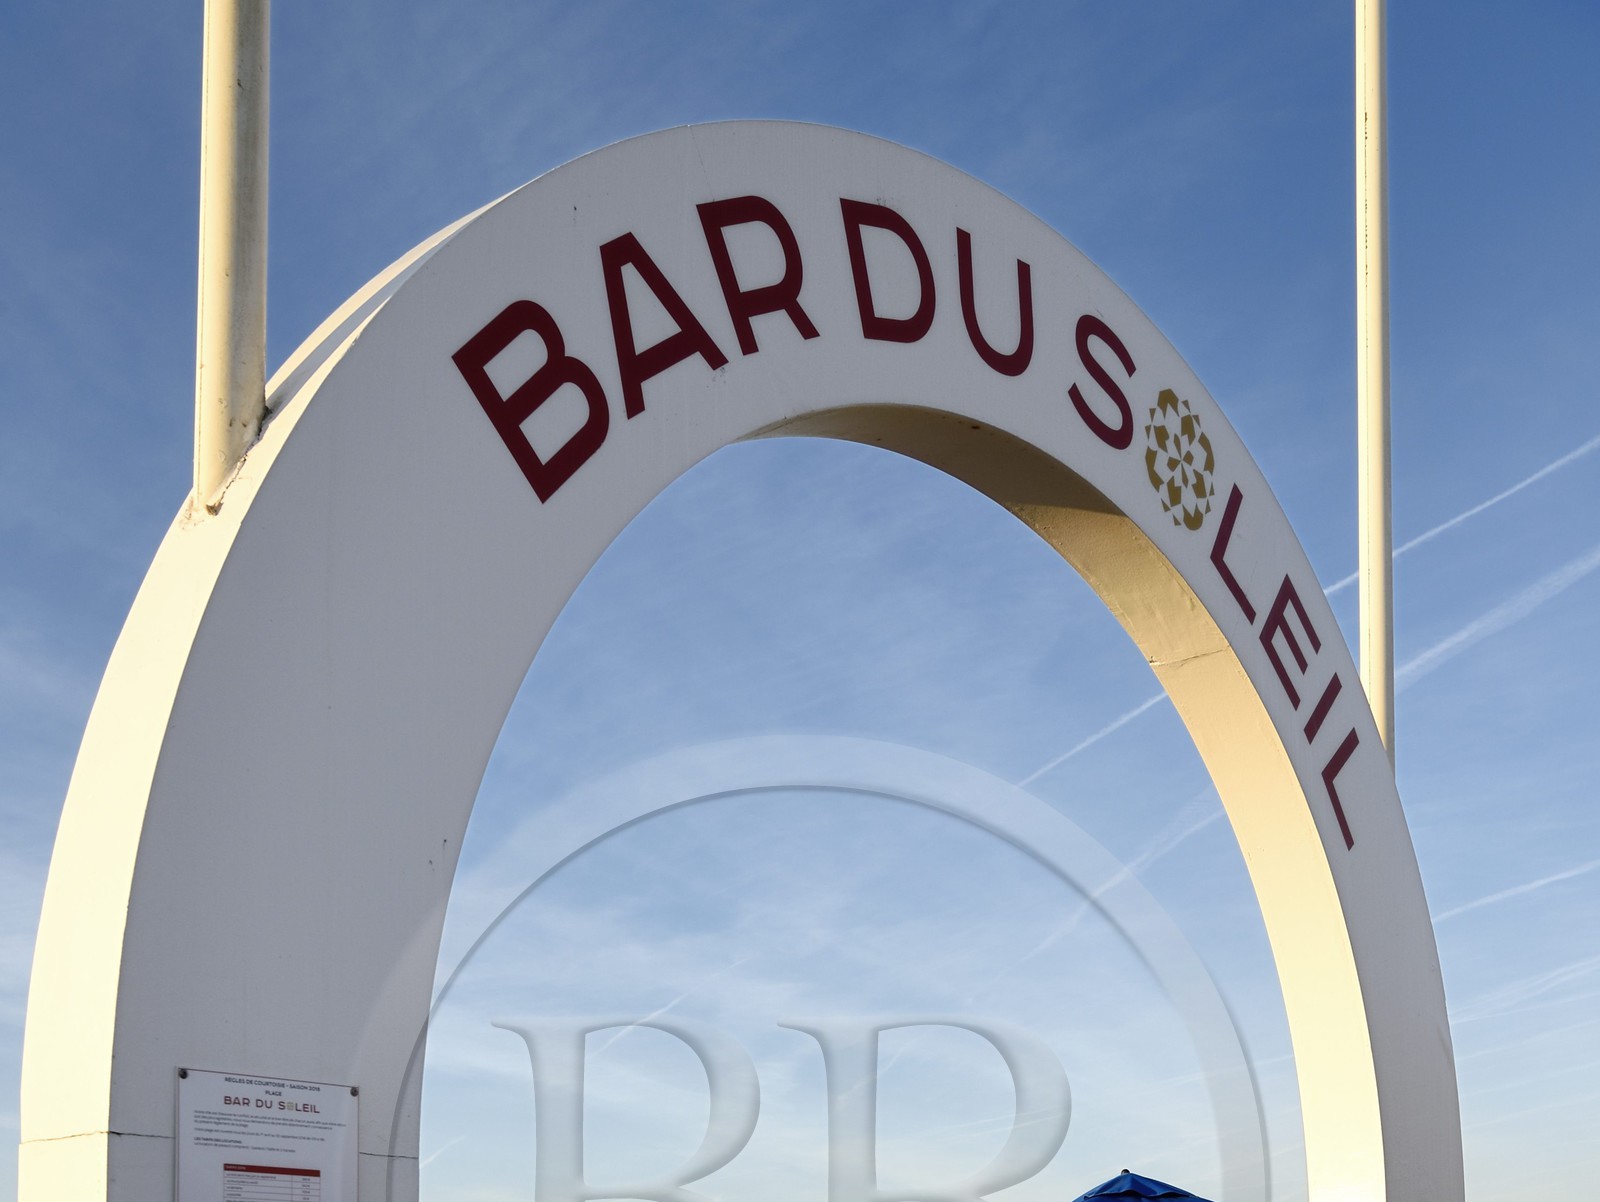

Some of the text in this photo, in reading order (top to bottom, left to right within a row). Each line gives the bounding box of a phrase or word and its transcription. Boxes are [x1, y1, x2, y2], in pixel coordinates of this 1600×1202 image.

[452, 195, 819, 503] BAR
[840, 198, 1033, 376] DU
[224, 1096, 250, 1106] BAR
[255, 1098, 273, 1109] DU
